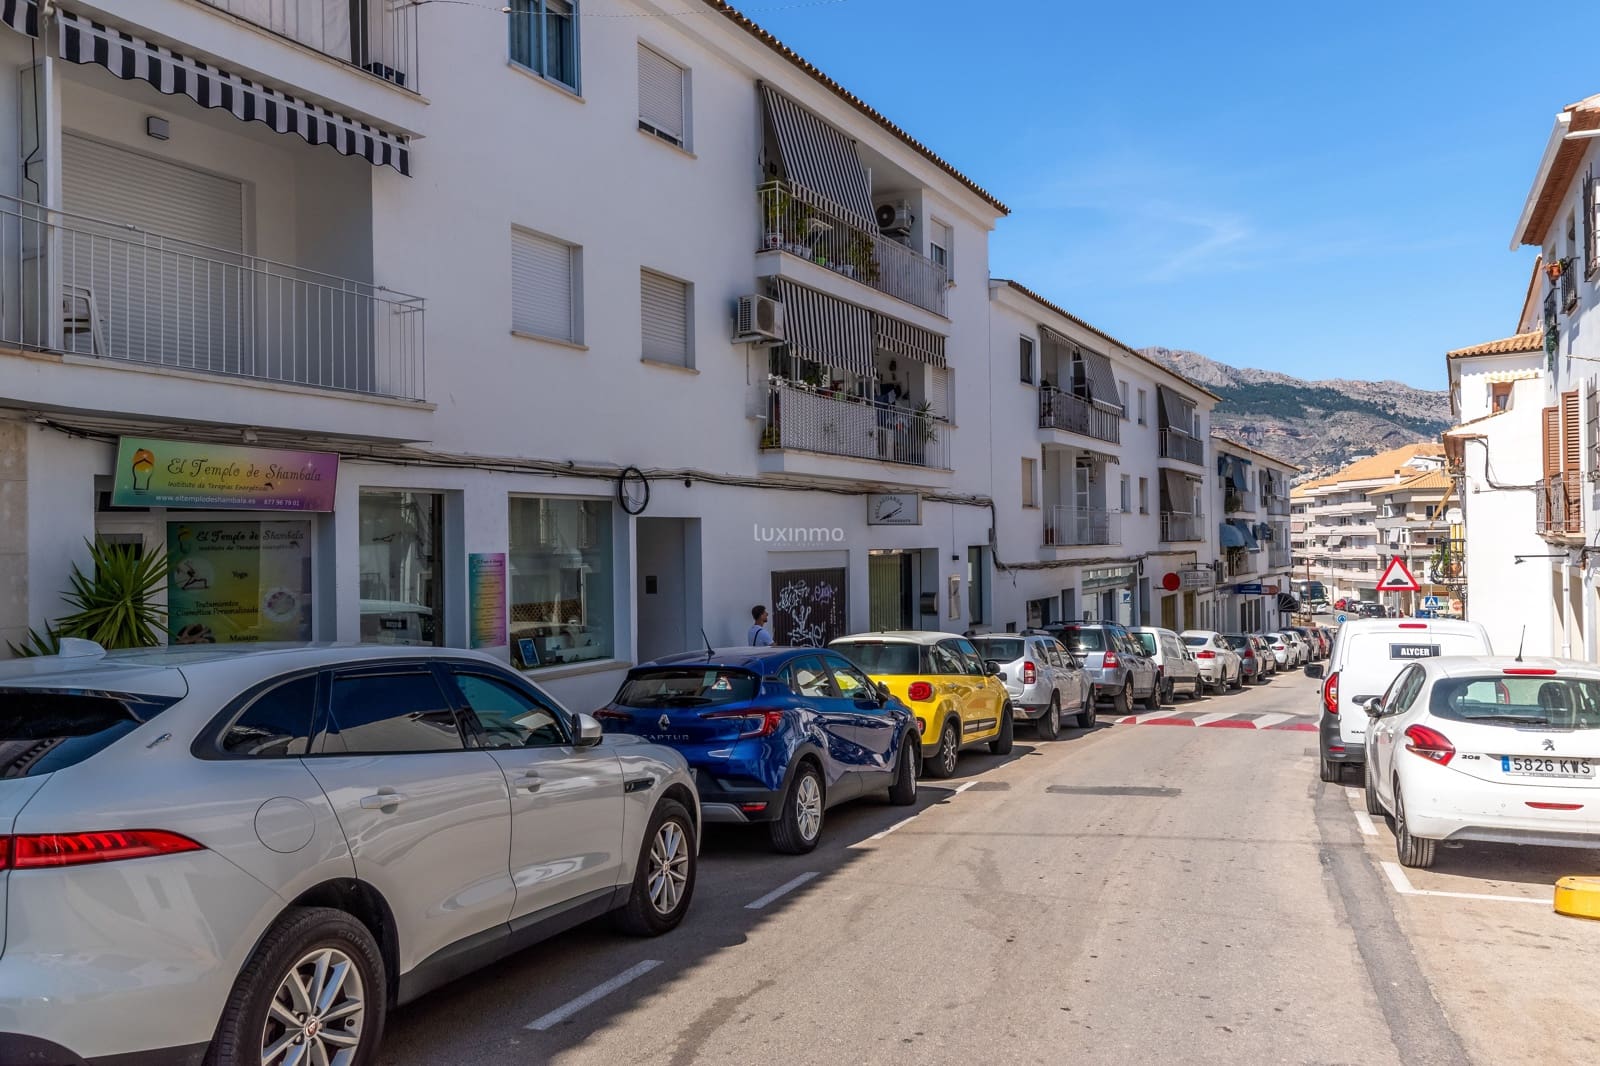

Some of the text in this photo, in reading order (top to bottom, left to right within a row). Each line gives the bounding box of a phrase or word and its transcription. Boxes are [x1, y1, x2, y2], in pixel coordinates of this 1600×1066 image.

[167, 458, 321, 482] El Templo de Shambala
[211, 530, 245, 544] Templo
[249, 530, 259, 540] de
[262, 529, 304, 541] Shambala
[1400, 647, 1430, 656] ALYCER
[1513, 757, 1590, 774] 5826 KWS
